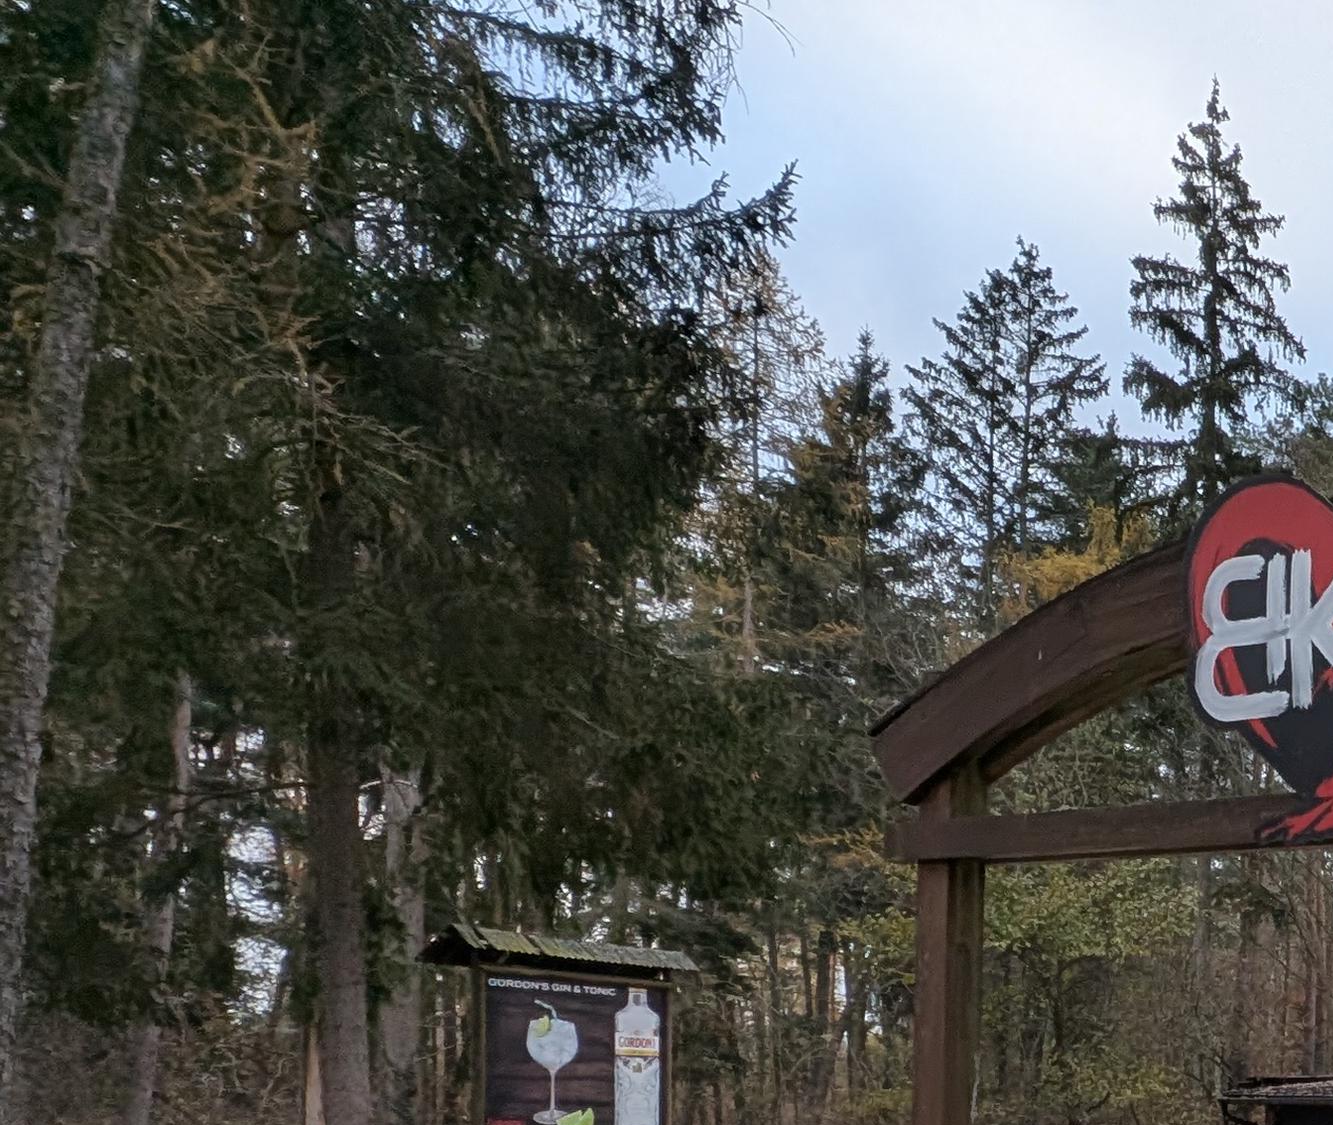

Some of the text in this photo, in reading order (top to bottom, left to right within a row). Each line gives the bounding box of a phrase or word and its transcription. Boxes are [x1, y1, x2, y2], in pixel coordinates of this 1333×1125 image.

[488, 977, 616, 996] GORDON'S GIN & TONIC
